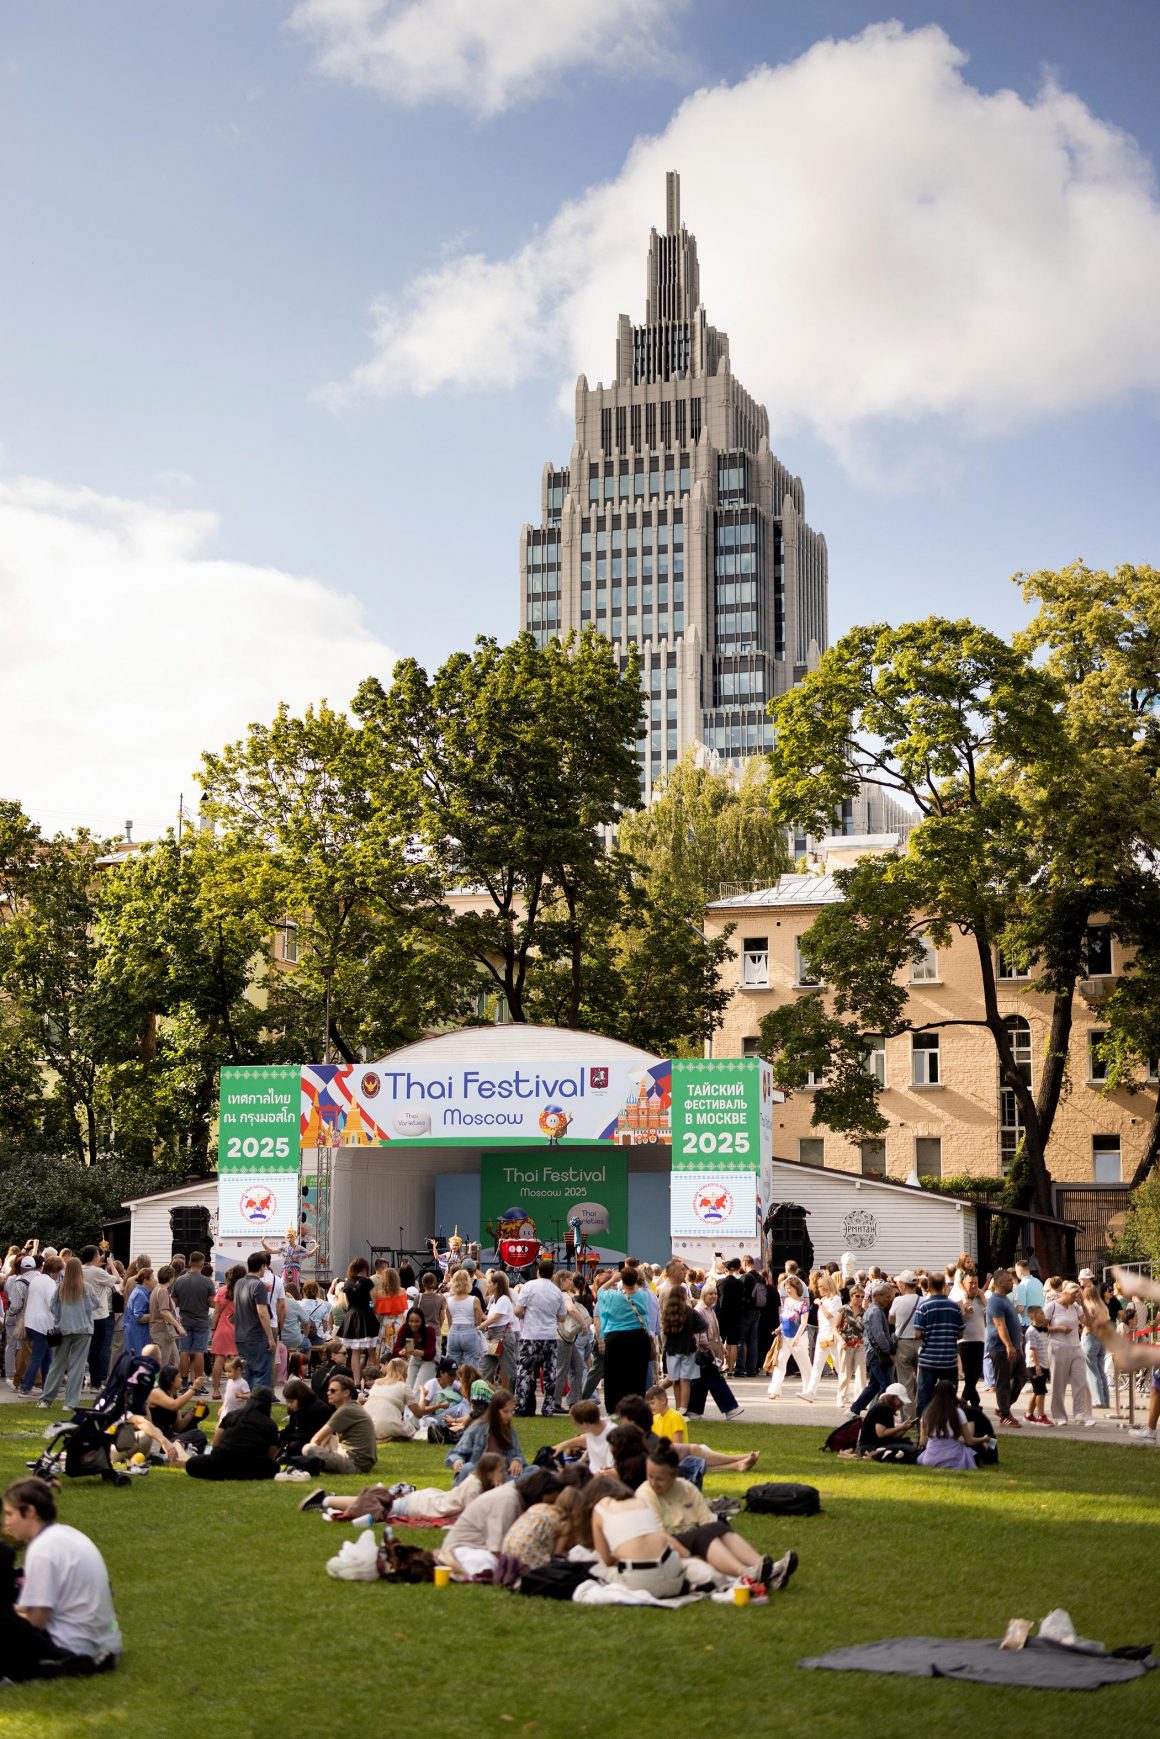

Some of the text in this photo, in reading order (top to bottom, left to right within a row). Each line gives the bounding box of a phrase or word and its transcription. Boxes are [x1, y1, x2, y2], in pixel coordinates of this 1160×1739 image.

[385, 1072, 453, 1099] Thai
[463, 1067, 585, 1098] Festival
[687, 1081, 744, 1096] ТАЙСКИЙ
[227, 1088, 291, 1104] เทศกาลไทย
[684, 1099, 748, 1110] ФЕСТИВАЛЬ
[223, 1107, 296, 1126] ณ กรุงมอสโก
[443, 1108, 524, 1126] Moscow
[685, 1113, 693, 1125] В
[696, 1113, 747, 1125] МОСКВЕ
[227, 1137, 290, 1158] 2025
[682, 1132, 750, 1153] 2025
[503, 1165, 606, 1182] Thai Festival
[520, 1187, 587, 1197] Moscow 2025
[582, 1209, 597, 1217] Thai
